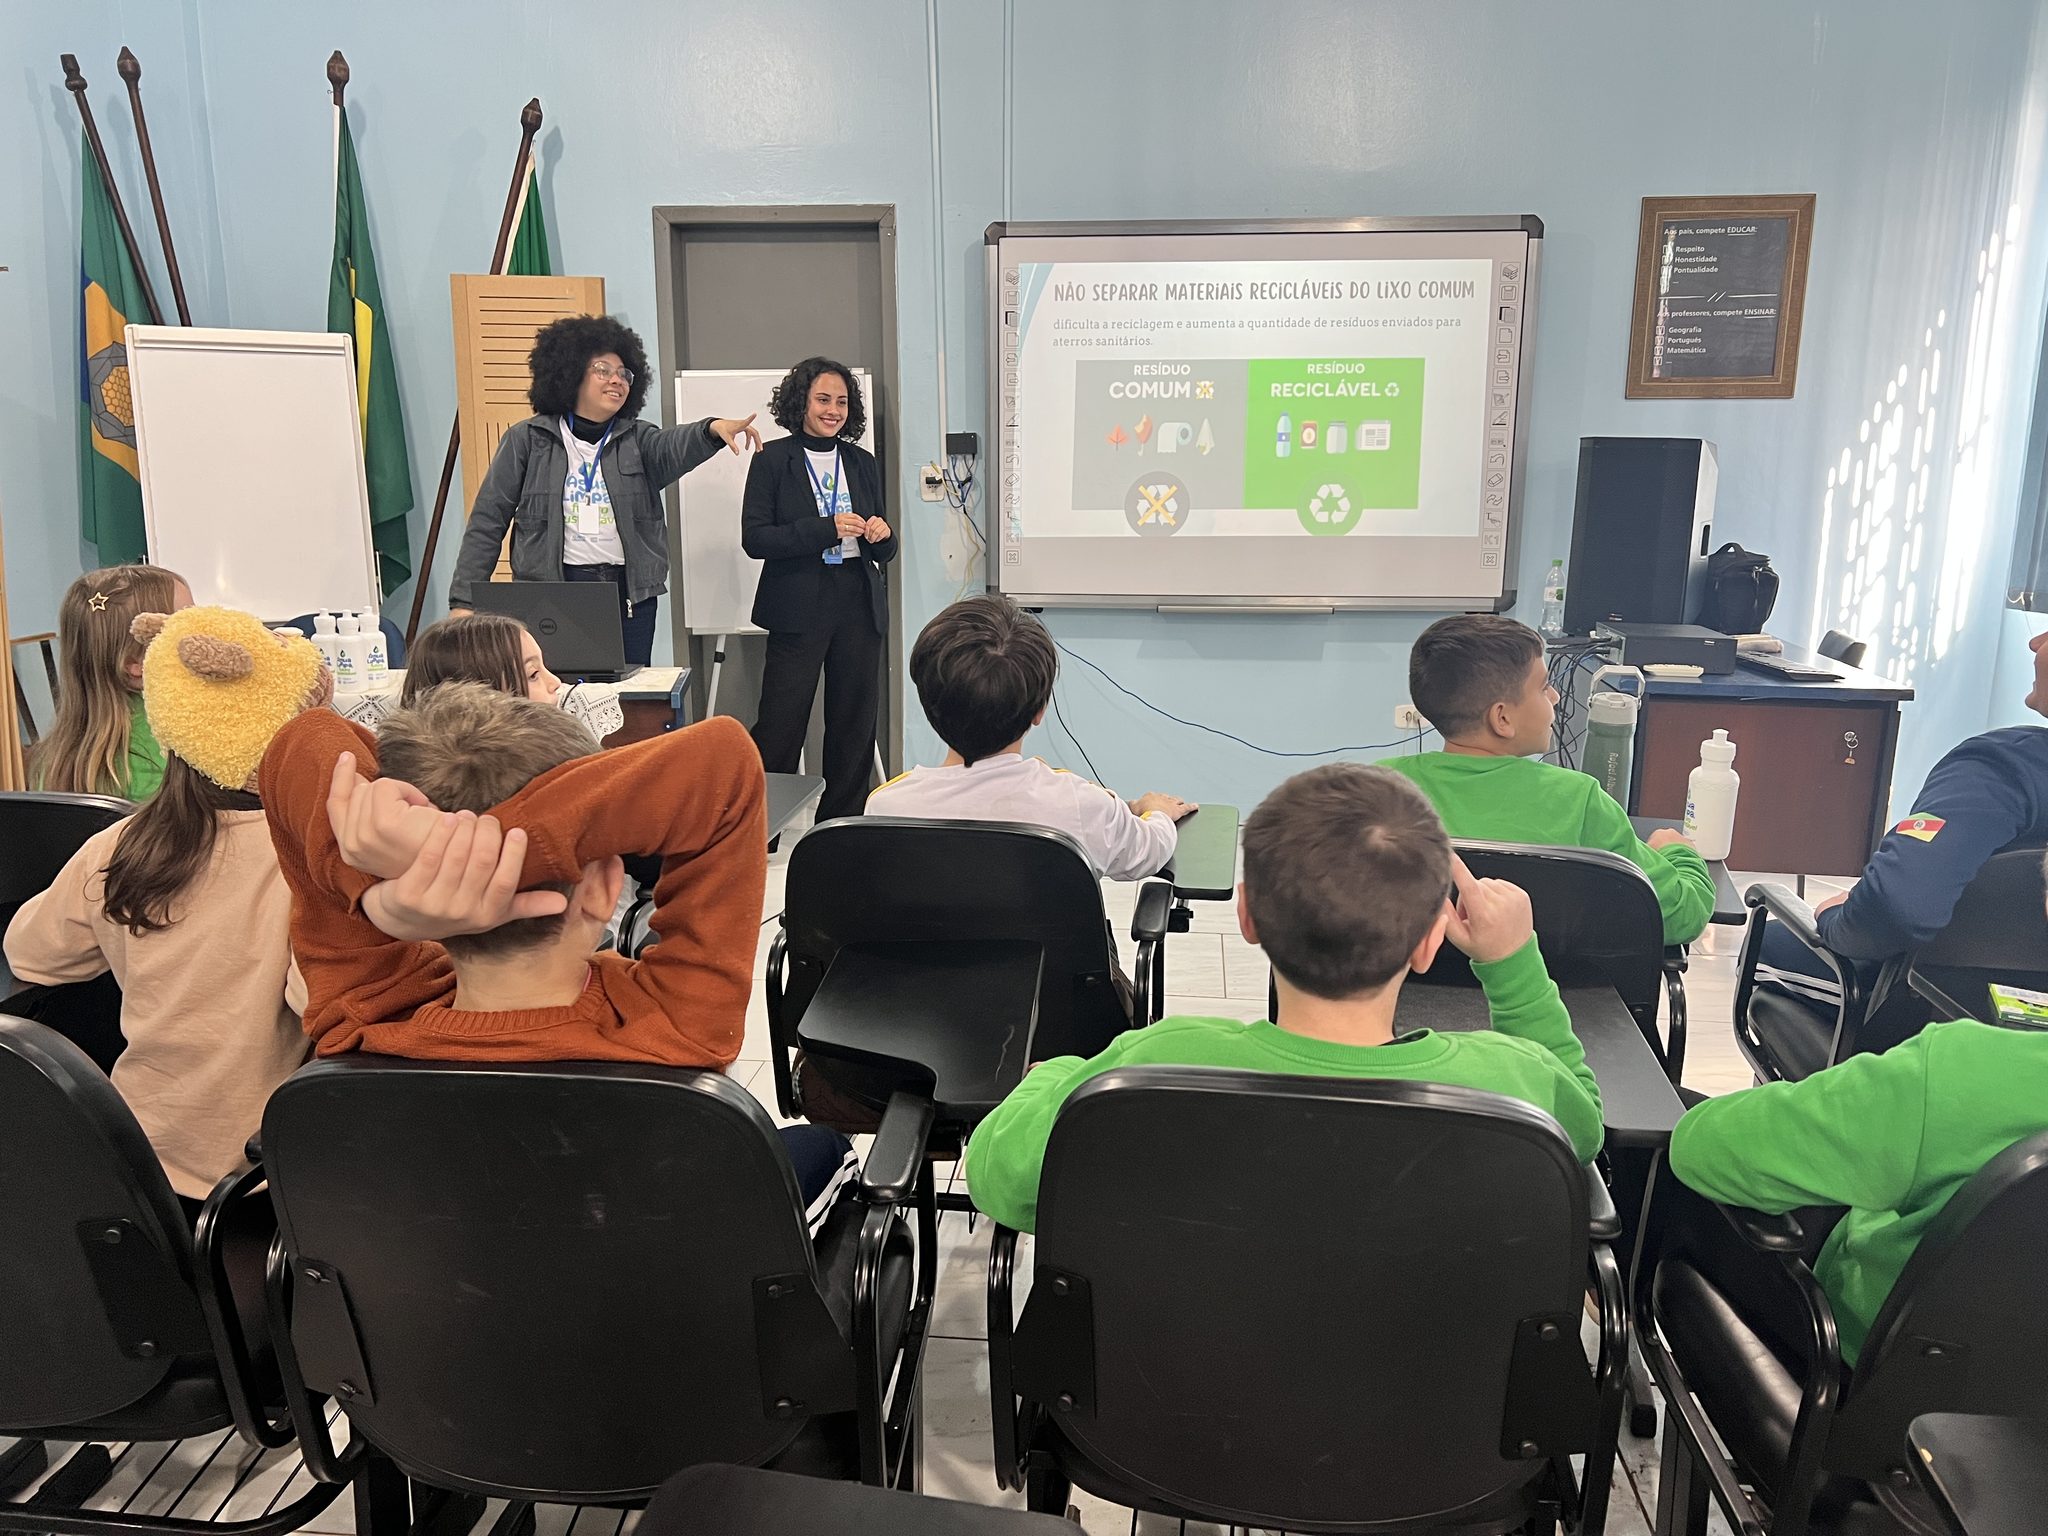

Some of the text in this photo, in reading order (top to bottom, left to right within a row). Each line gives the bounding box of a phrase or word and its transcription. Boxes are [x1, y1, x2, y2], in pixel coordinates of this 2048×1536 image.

[1696, 227, 1726, 235] compete
[1675, 245, 1705, 254] Respeito
[1674, 255, 1718, 263] Honestidade
[1673, 265, 1719, 274] Pontualidade
[1092, 282, 1159, 301] SEPARAR
[1350, 280, 1370, 299] DO
[1418, 280, 1475, 299] COMUM
[1713, 309, 1743, 317] compete
[1053, 316, 1462, 331] dificulta a reciclagem e aumenta a quantidade de resíduos enviados para
[1668, 326, 1702, 335] Geografia
[1052, 335, 1153, 347] aterros sanitários.
[1666, 346, 1706, 354] Matemática
[1133, 362, 1191, 376] RESÍDUO
[1307, 360, 1365, 375] RESÍDUO
[1109, 381, 1191, 399] COMUM
[1271, 379, 1381, 398] RECICLÁVEL
